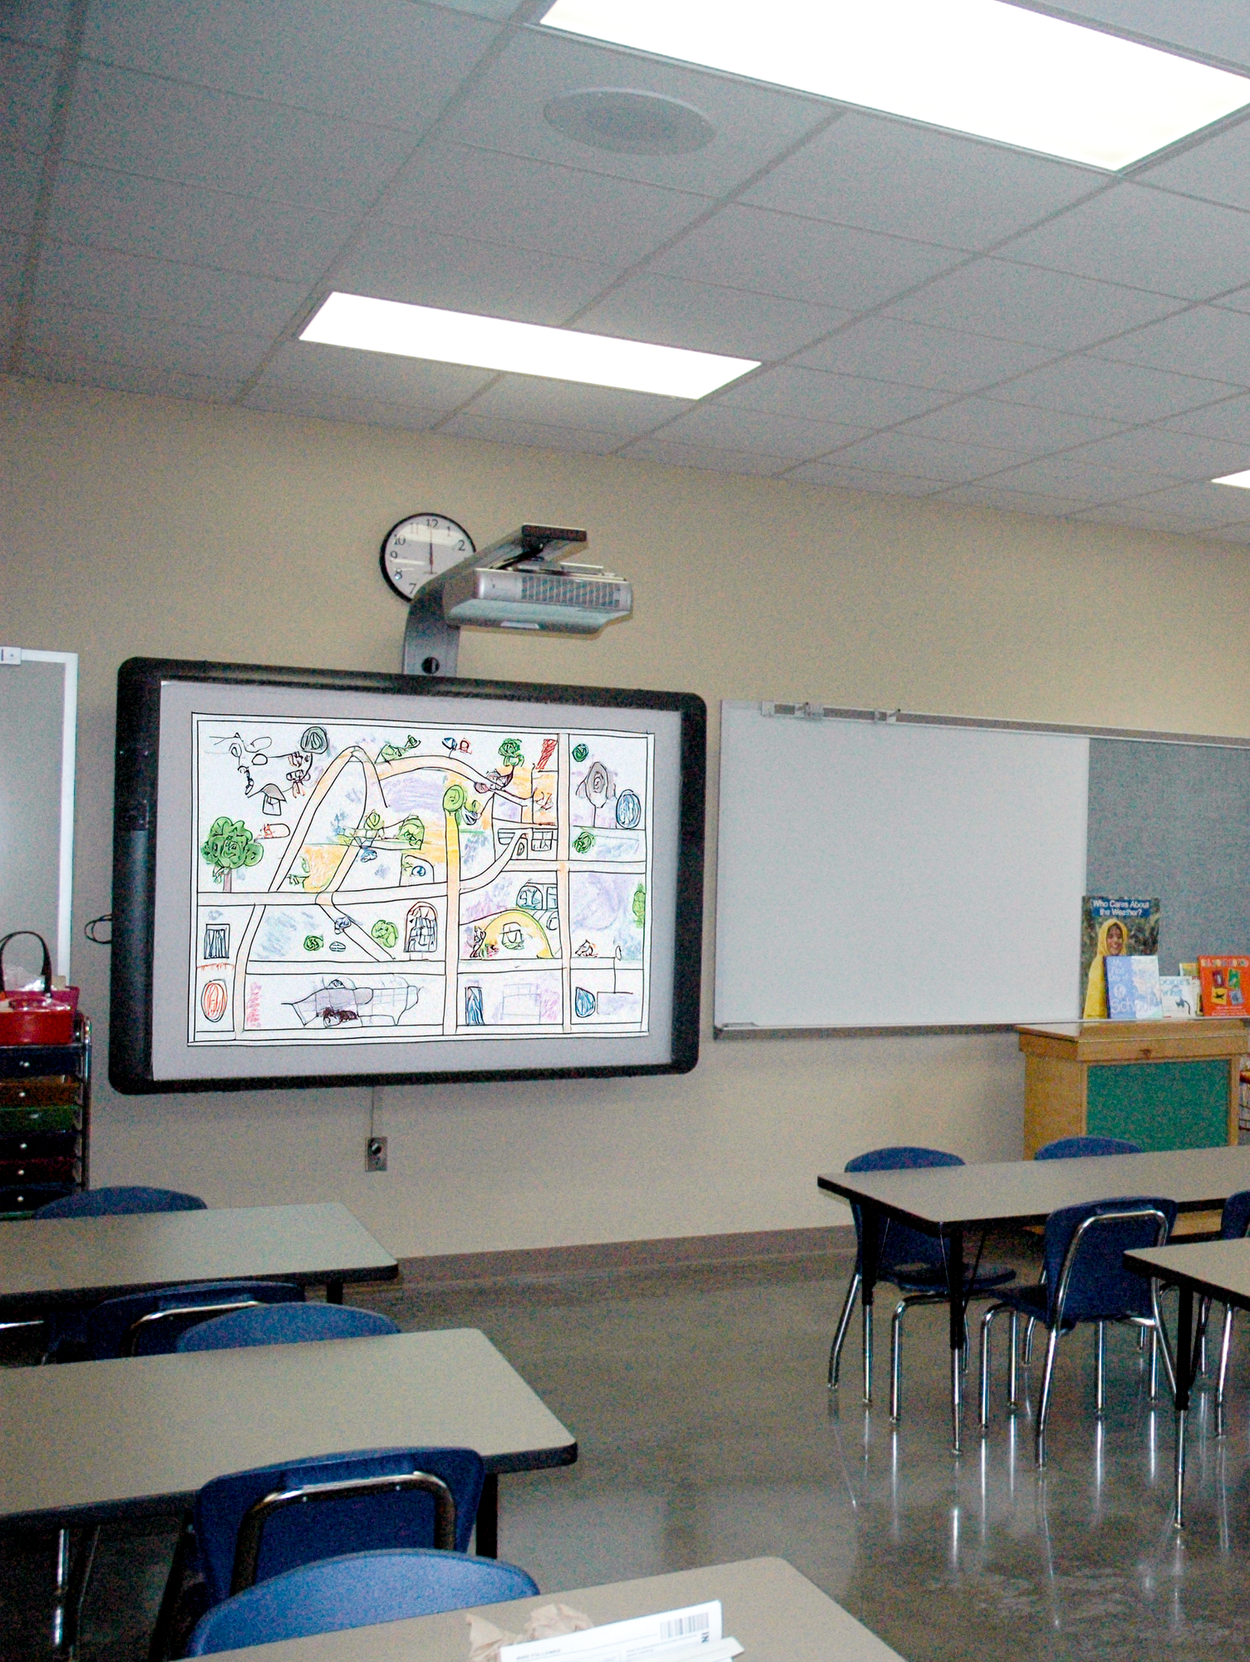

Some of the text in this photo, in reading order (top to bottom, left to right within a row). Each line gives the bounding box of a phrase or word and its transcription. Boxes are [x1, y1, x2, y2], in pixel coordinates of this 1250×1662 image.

[410, 523, 419, 534] 11
[426, 519, 438, 528] 12
[446, 526, 451, 537] 1
[394, 534, 406, 545] 10
[458, 540, 466, 551] 2
[390, 551, 398, 562] 9
[394, 568, 403, 580] 8
[408, 583, 417, 594] 7
[1109, 900, 1129, 909] Cares
[1129, 900, 1150, 909] About
[1099, 908, 1143, 916] the Weather?
